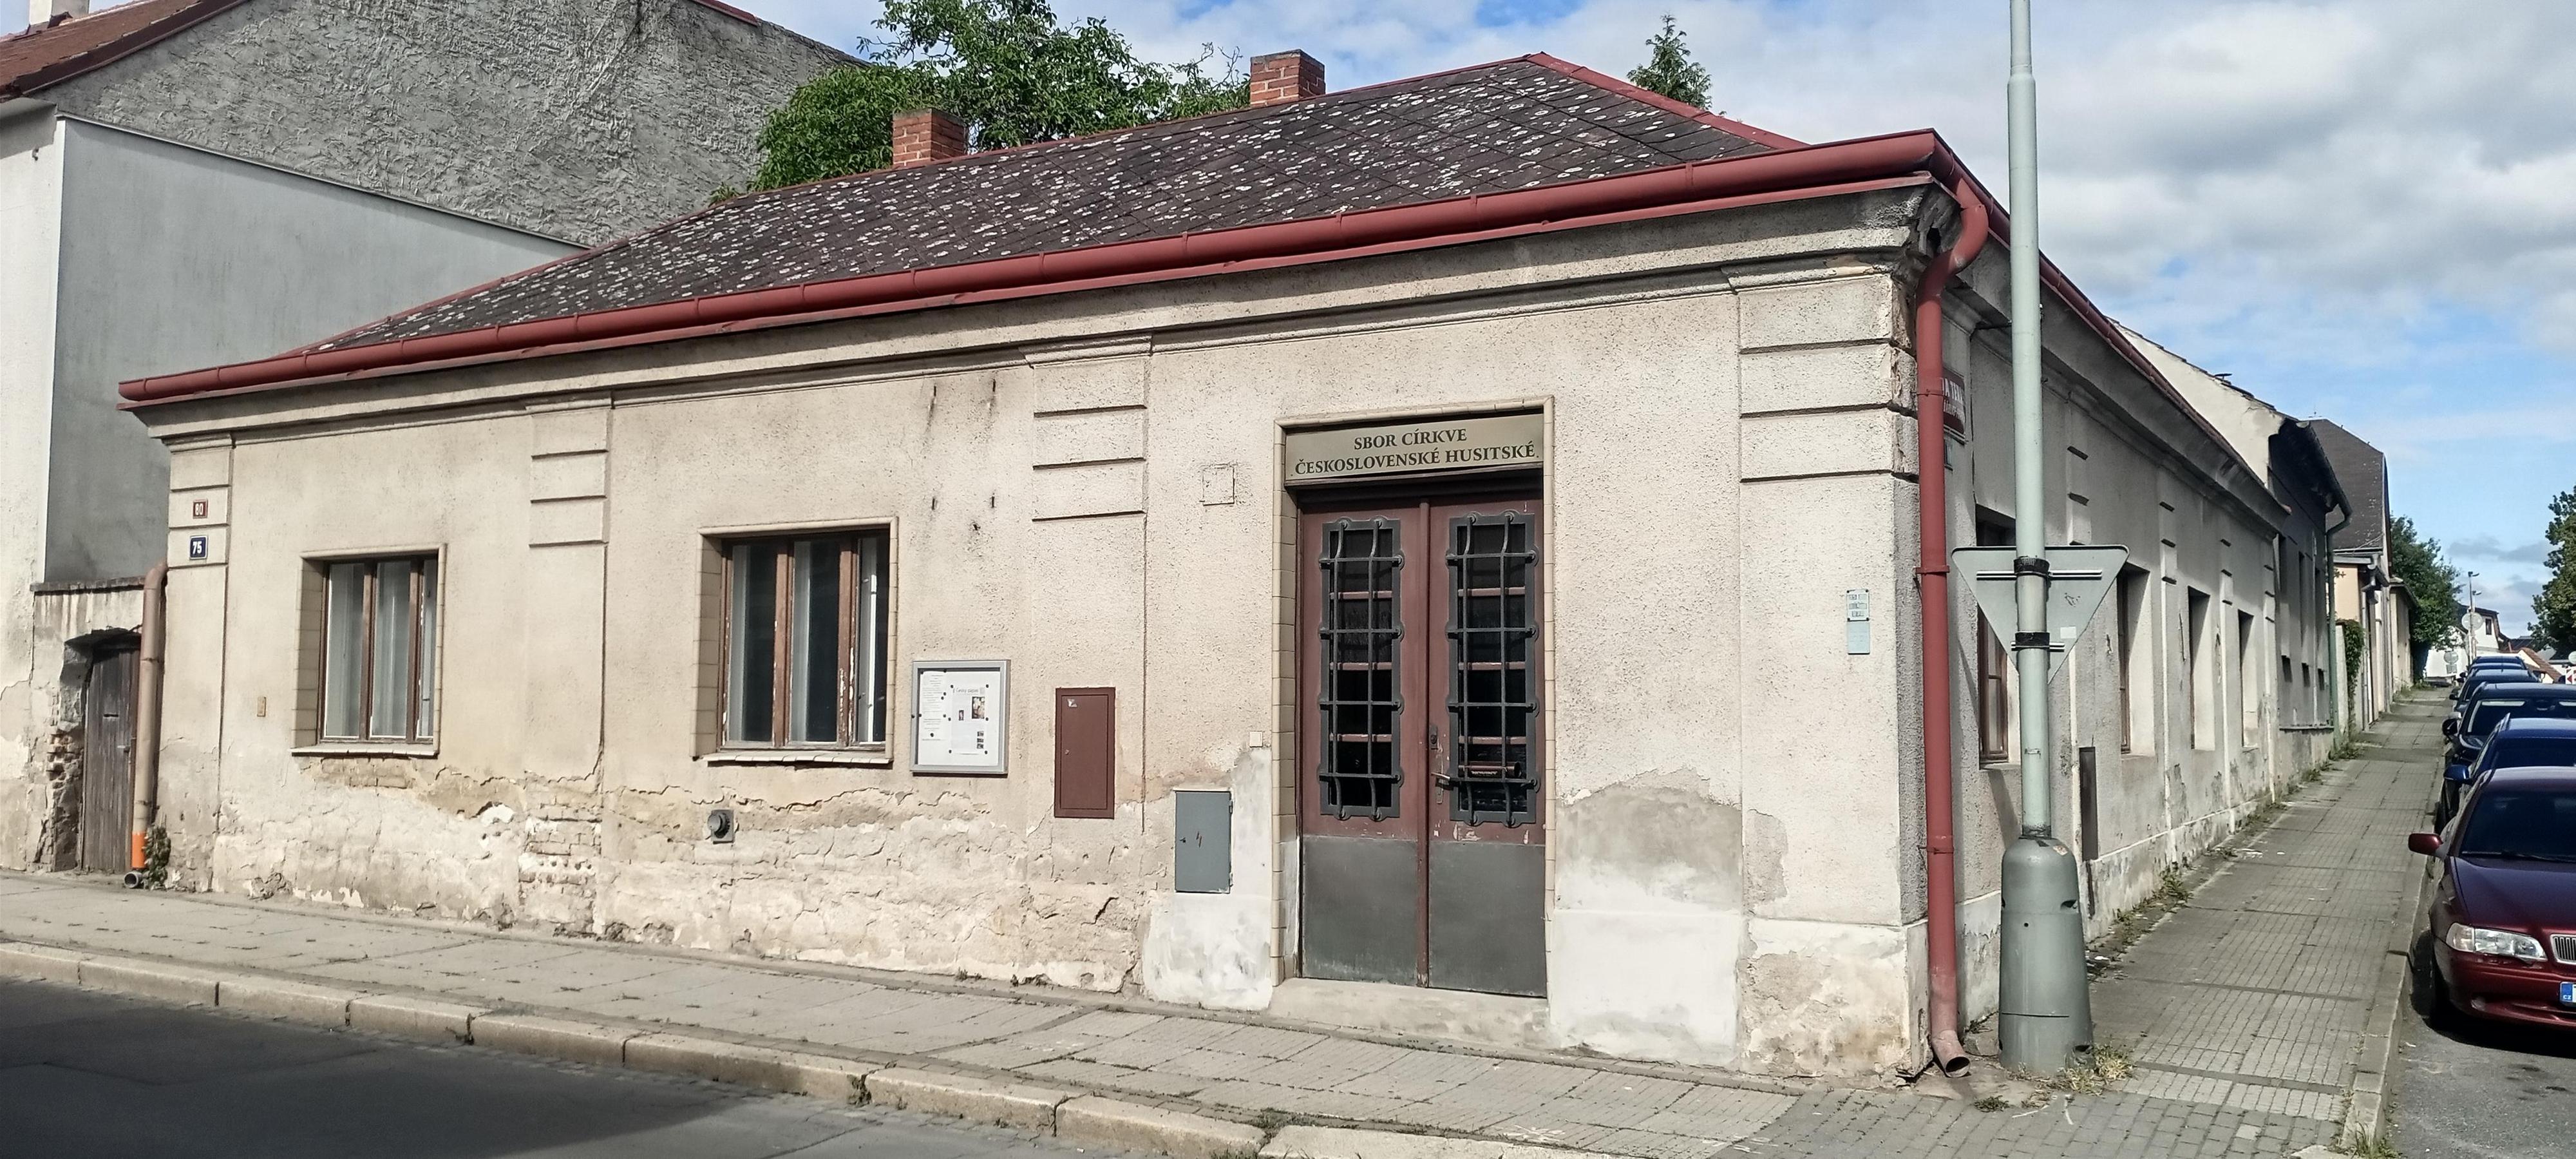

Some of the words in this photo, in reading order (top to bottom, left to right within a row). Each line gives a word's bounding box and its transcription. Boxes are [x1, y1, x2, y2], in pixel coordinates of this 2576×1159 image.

[1354, 434, 1397, 450] SBOR
[1401, 428, 1467, 446] CÍRKVE
[1295, 447, 1441, 475] ČESKOSLOVENSKÉ
[1445, 441, 1535, 463] HUSITSKÉ
[194, 503, 204, 515] 80
[193, 541, 202, 554] 75
